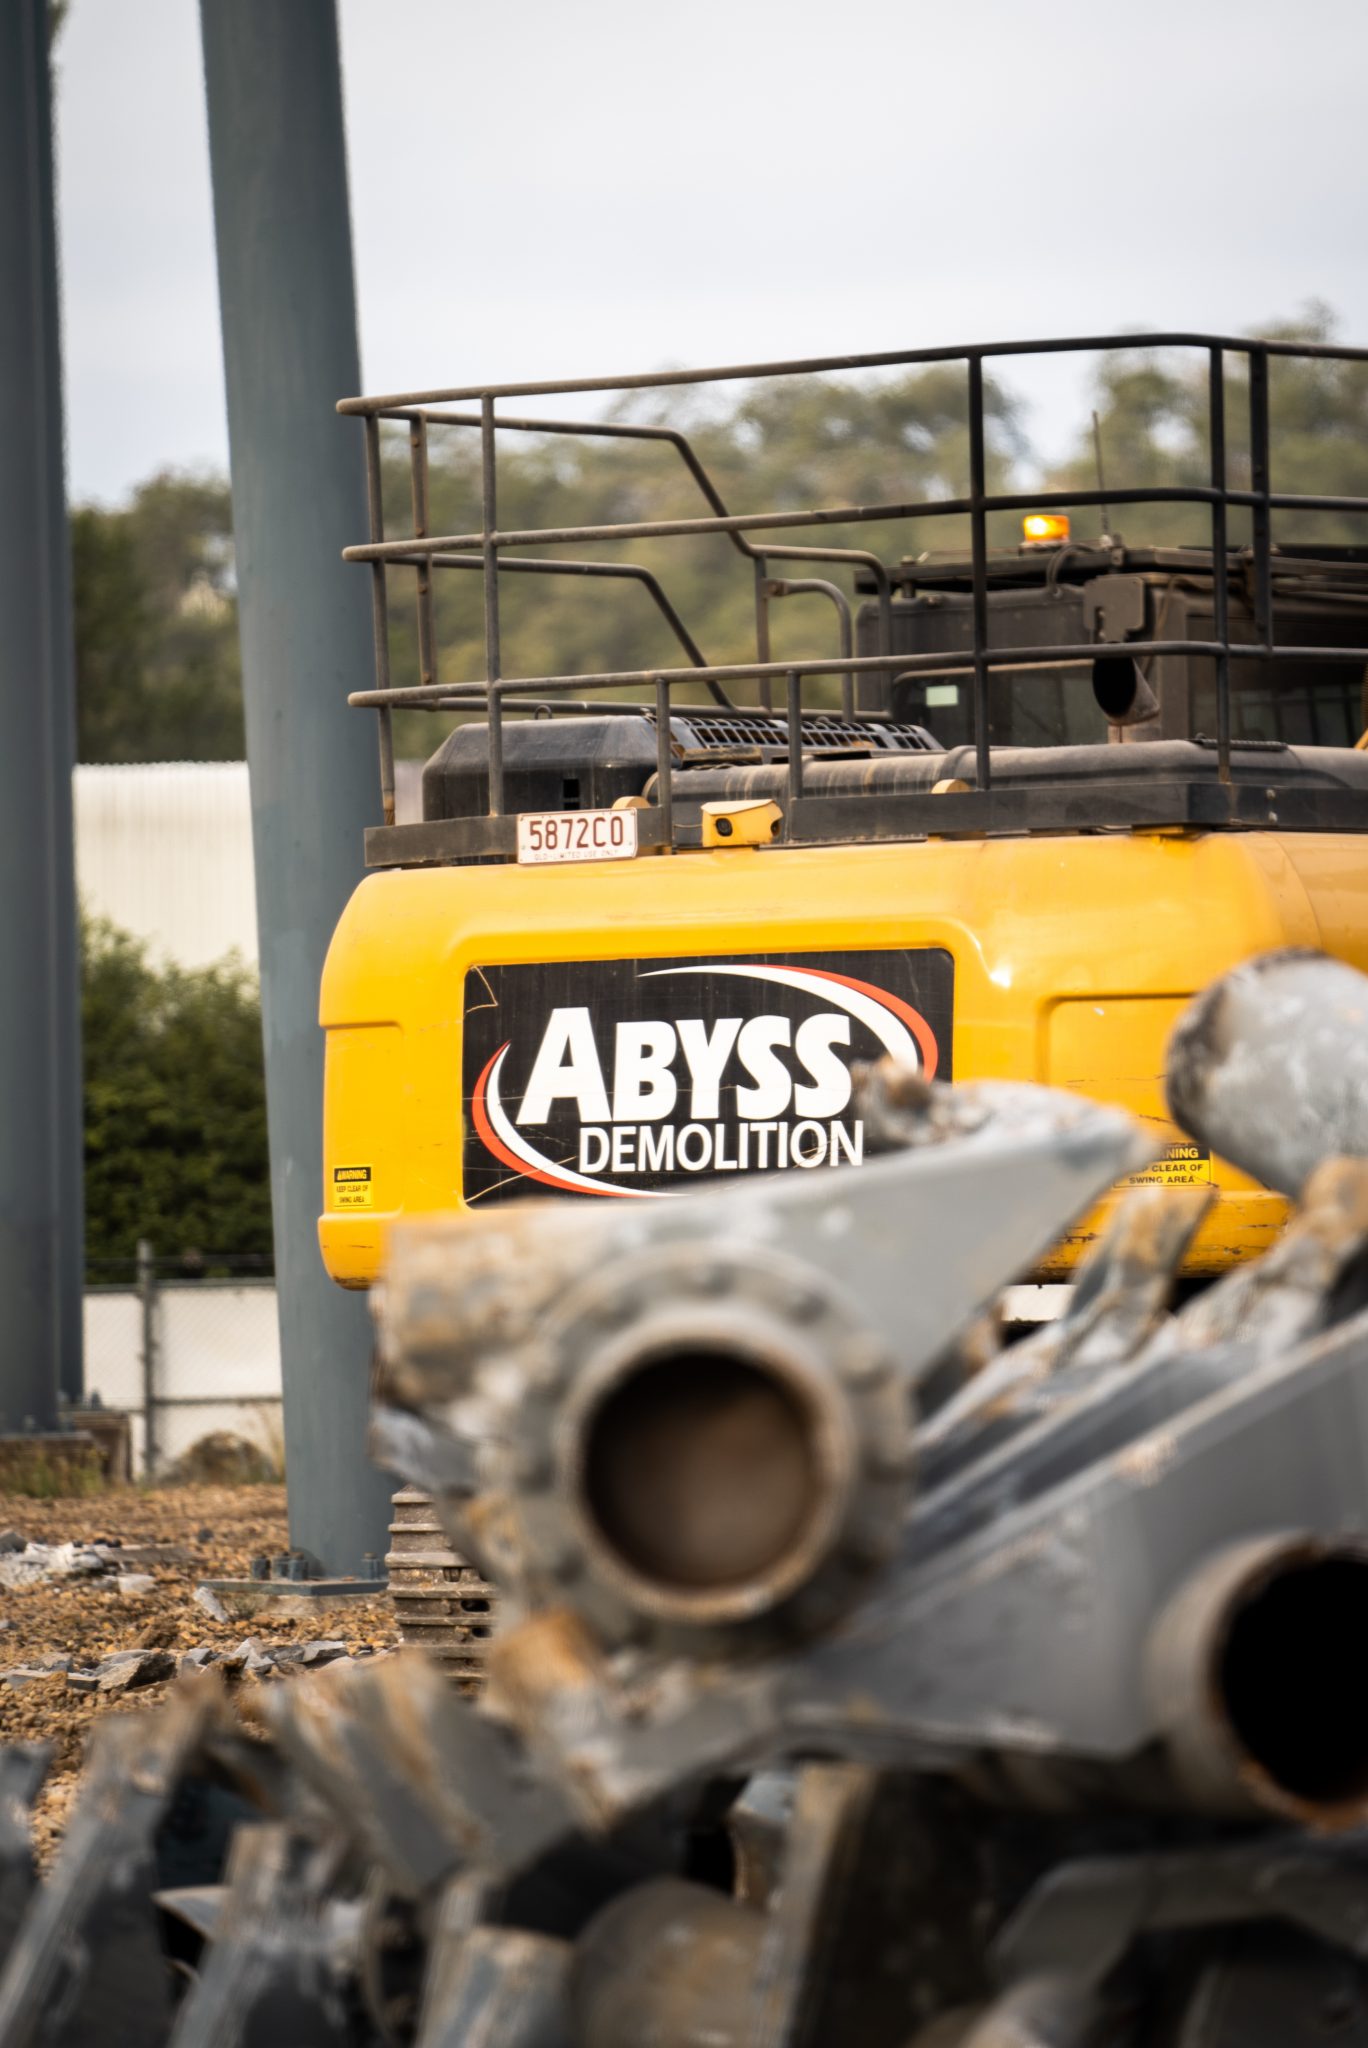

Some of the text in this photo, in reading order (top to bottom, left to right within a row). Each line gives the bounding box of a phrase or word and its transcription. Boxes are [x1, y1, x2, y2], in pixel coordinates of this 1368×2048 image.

[515, 1006, 852, 1125] ABYSS
[579, 1120, 864, 1174] DEMOLITION
[1128, 1175, 1196, 1185] SWING AREA
[1151, 1163, 1187, 1173] CLEAR
[1189, 1163, 1204, 1172] OF
